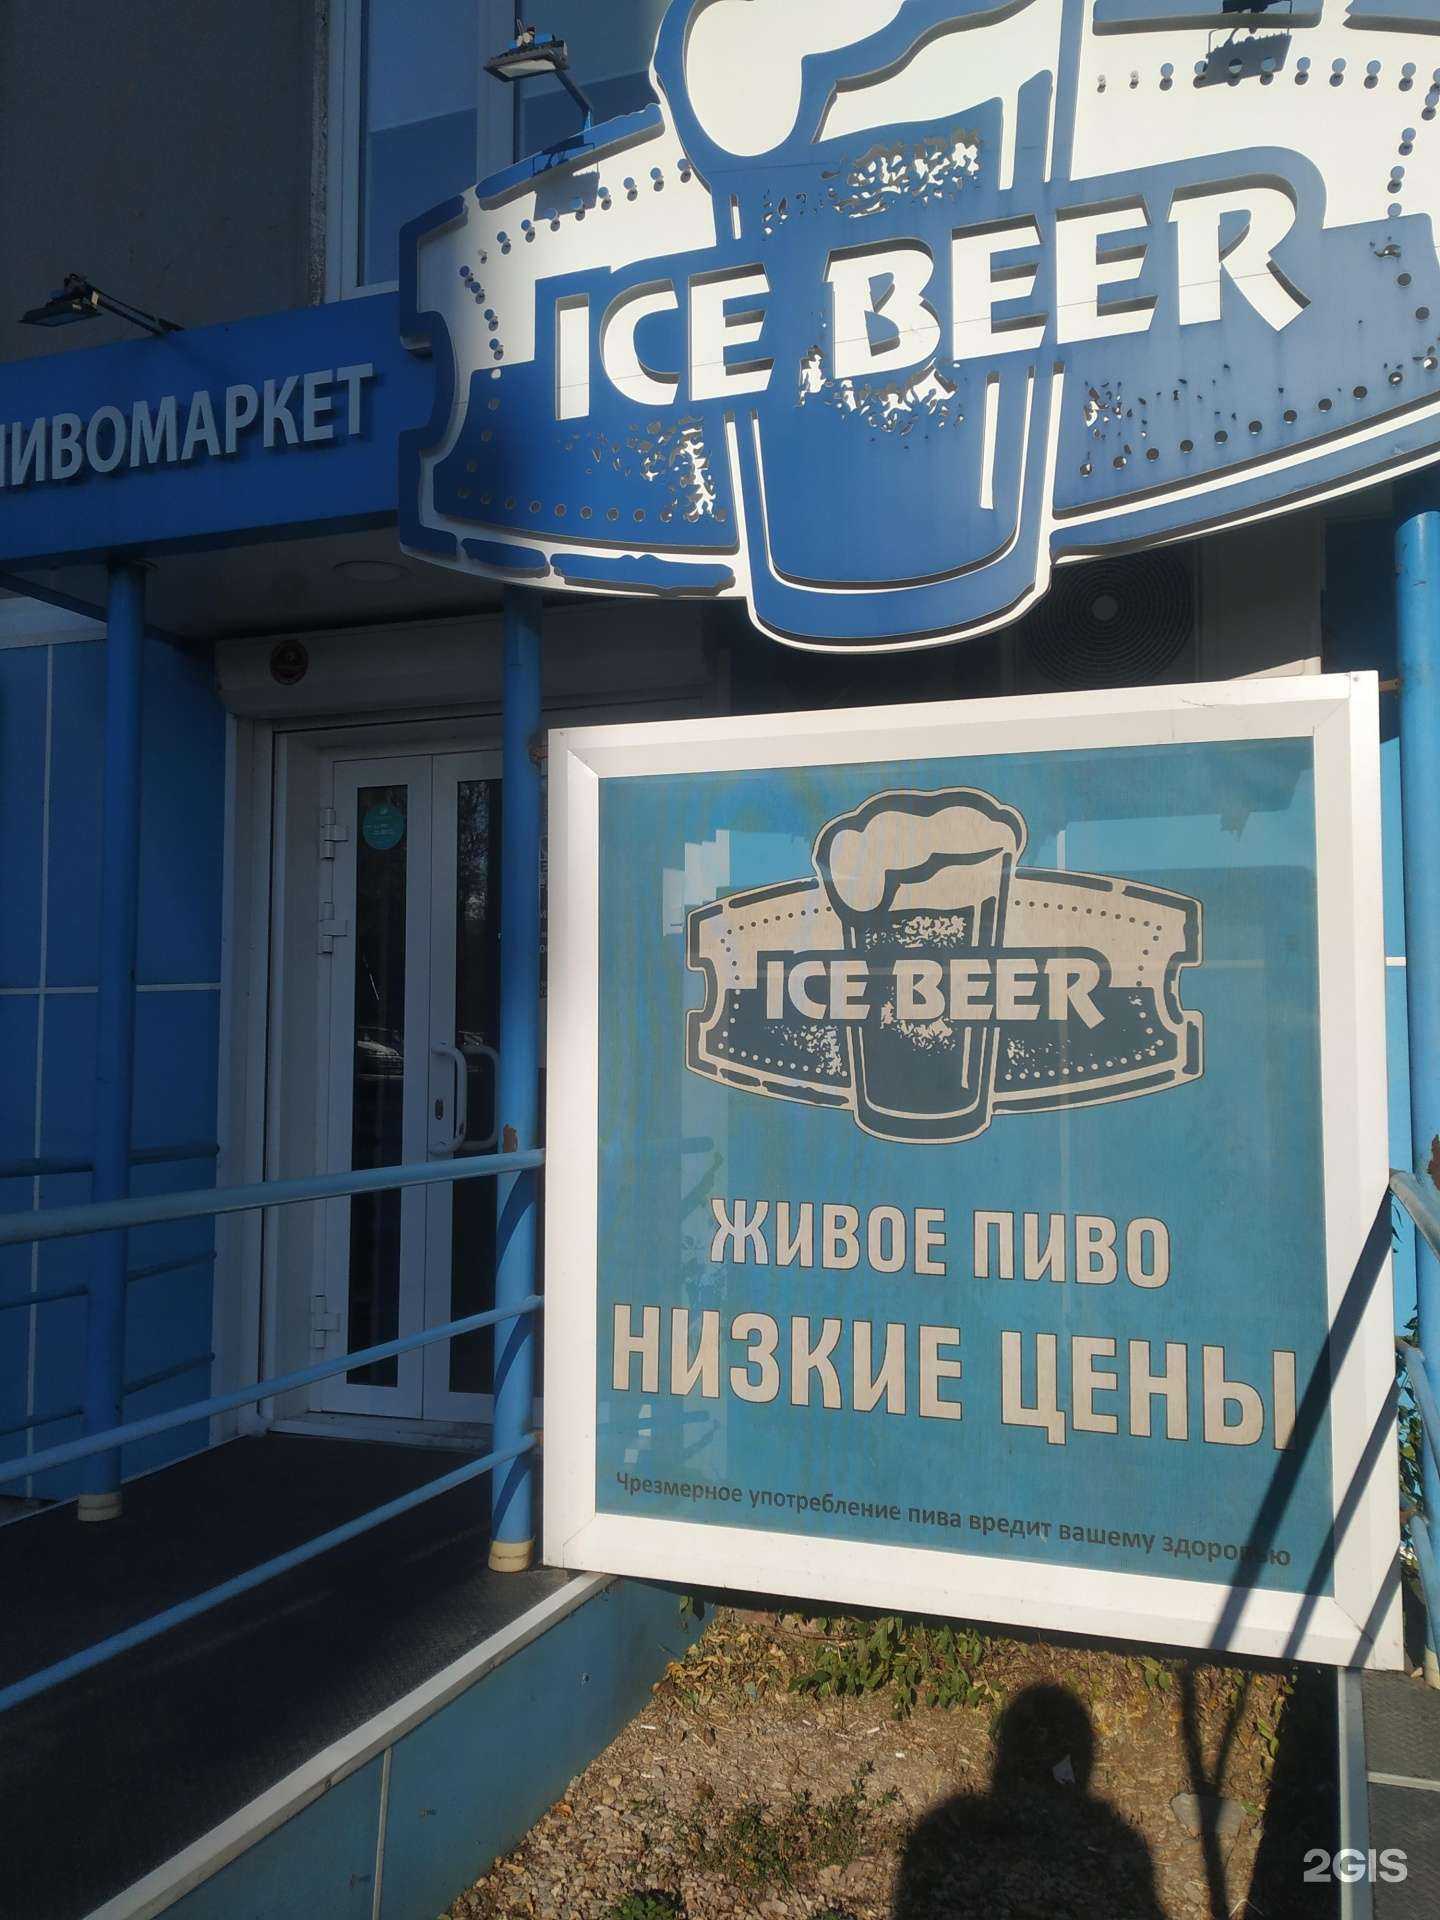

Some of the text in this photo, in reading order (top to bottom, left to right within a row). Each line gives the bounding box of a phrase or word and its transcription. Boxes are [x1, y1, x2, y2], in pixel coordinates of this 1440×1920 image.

[555, 174, 1311, 421] ICE BEER
[0, 362, 374, 487] ИВОМАРКЕТ
[766, 958, 1105, 1029] ICE BEER
[710, 1198, 1170, 1288] ЖИВОЕ ПИВО
[612, 1304, 1296, 1451] НИЗКИЕ ЦЕНЫ
[616, 1471, 743, 1504] Чрезмерное
[749, 1487, 901, 1521] употребление
[907, 1506, 962, 1529] пива
[968, 1513, 1051, 1543] вредит
[1059, 1523, 1156, 1555] вашему
